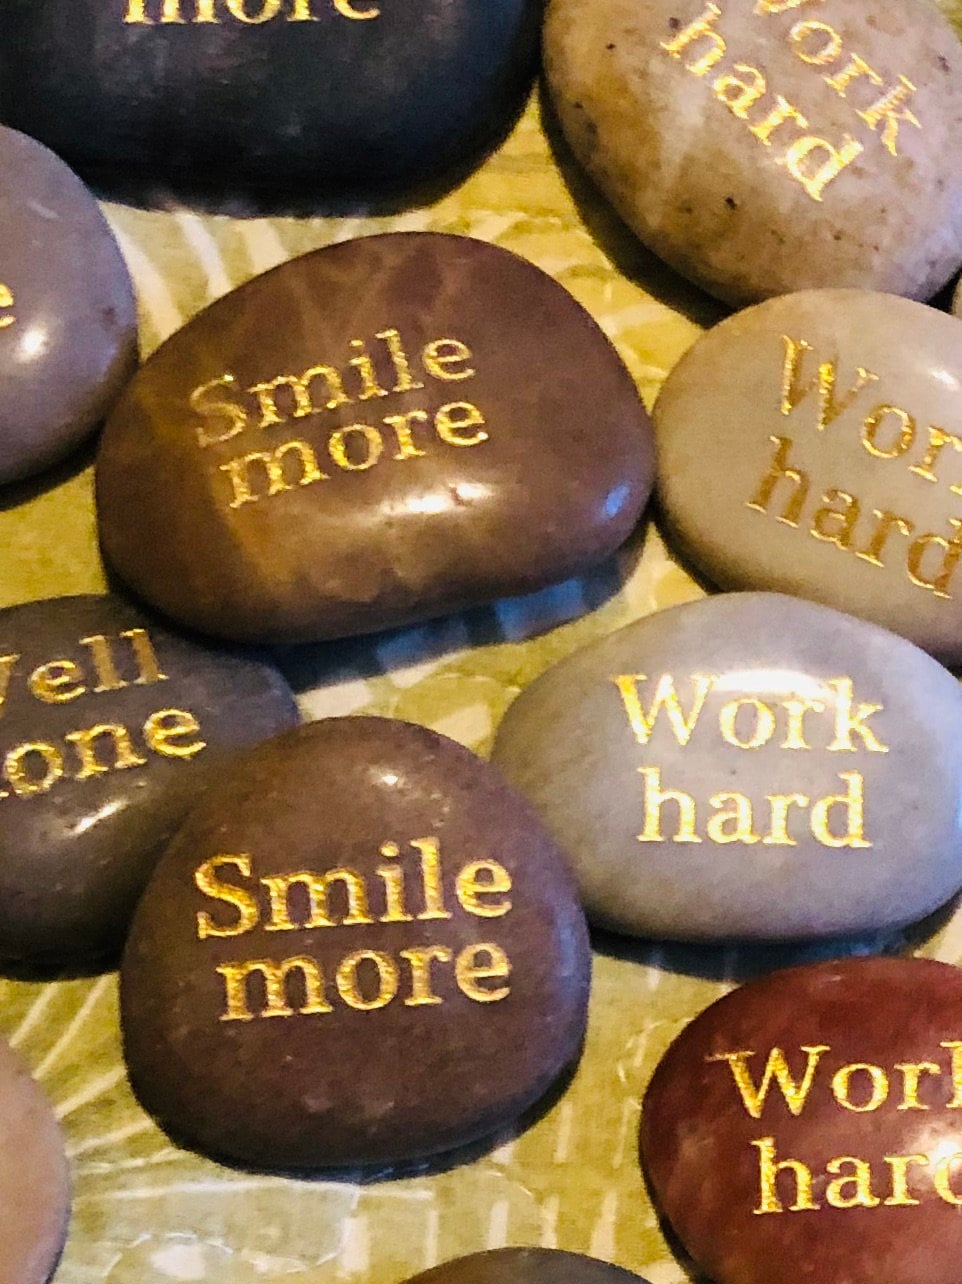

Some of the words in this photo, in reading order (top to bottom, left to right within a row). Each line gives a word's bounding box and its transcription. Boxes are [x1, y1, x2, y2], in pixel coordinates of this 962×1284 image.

[659, 2, 864, 202] hard
[754, 0, 922, 156] ork
[189, 329, 476, 448] Smile
[220, 400, 488, 508] more
[0, 708, 207, 797] one
[613, 674, 889, 753] Work
[637, 767, 872, 849] hard
[194, 836, 513, 940] Smile
[215, 942, 512, 1021] more
